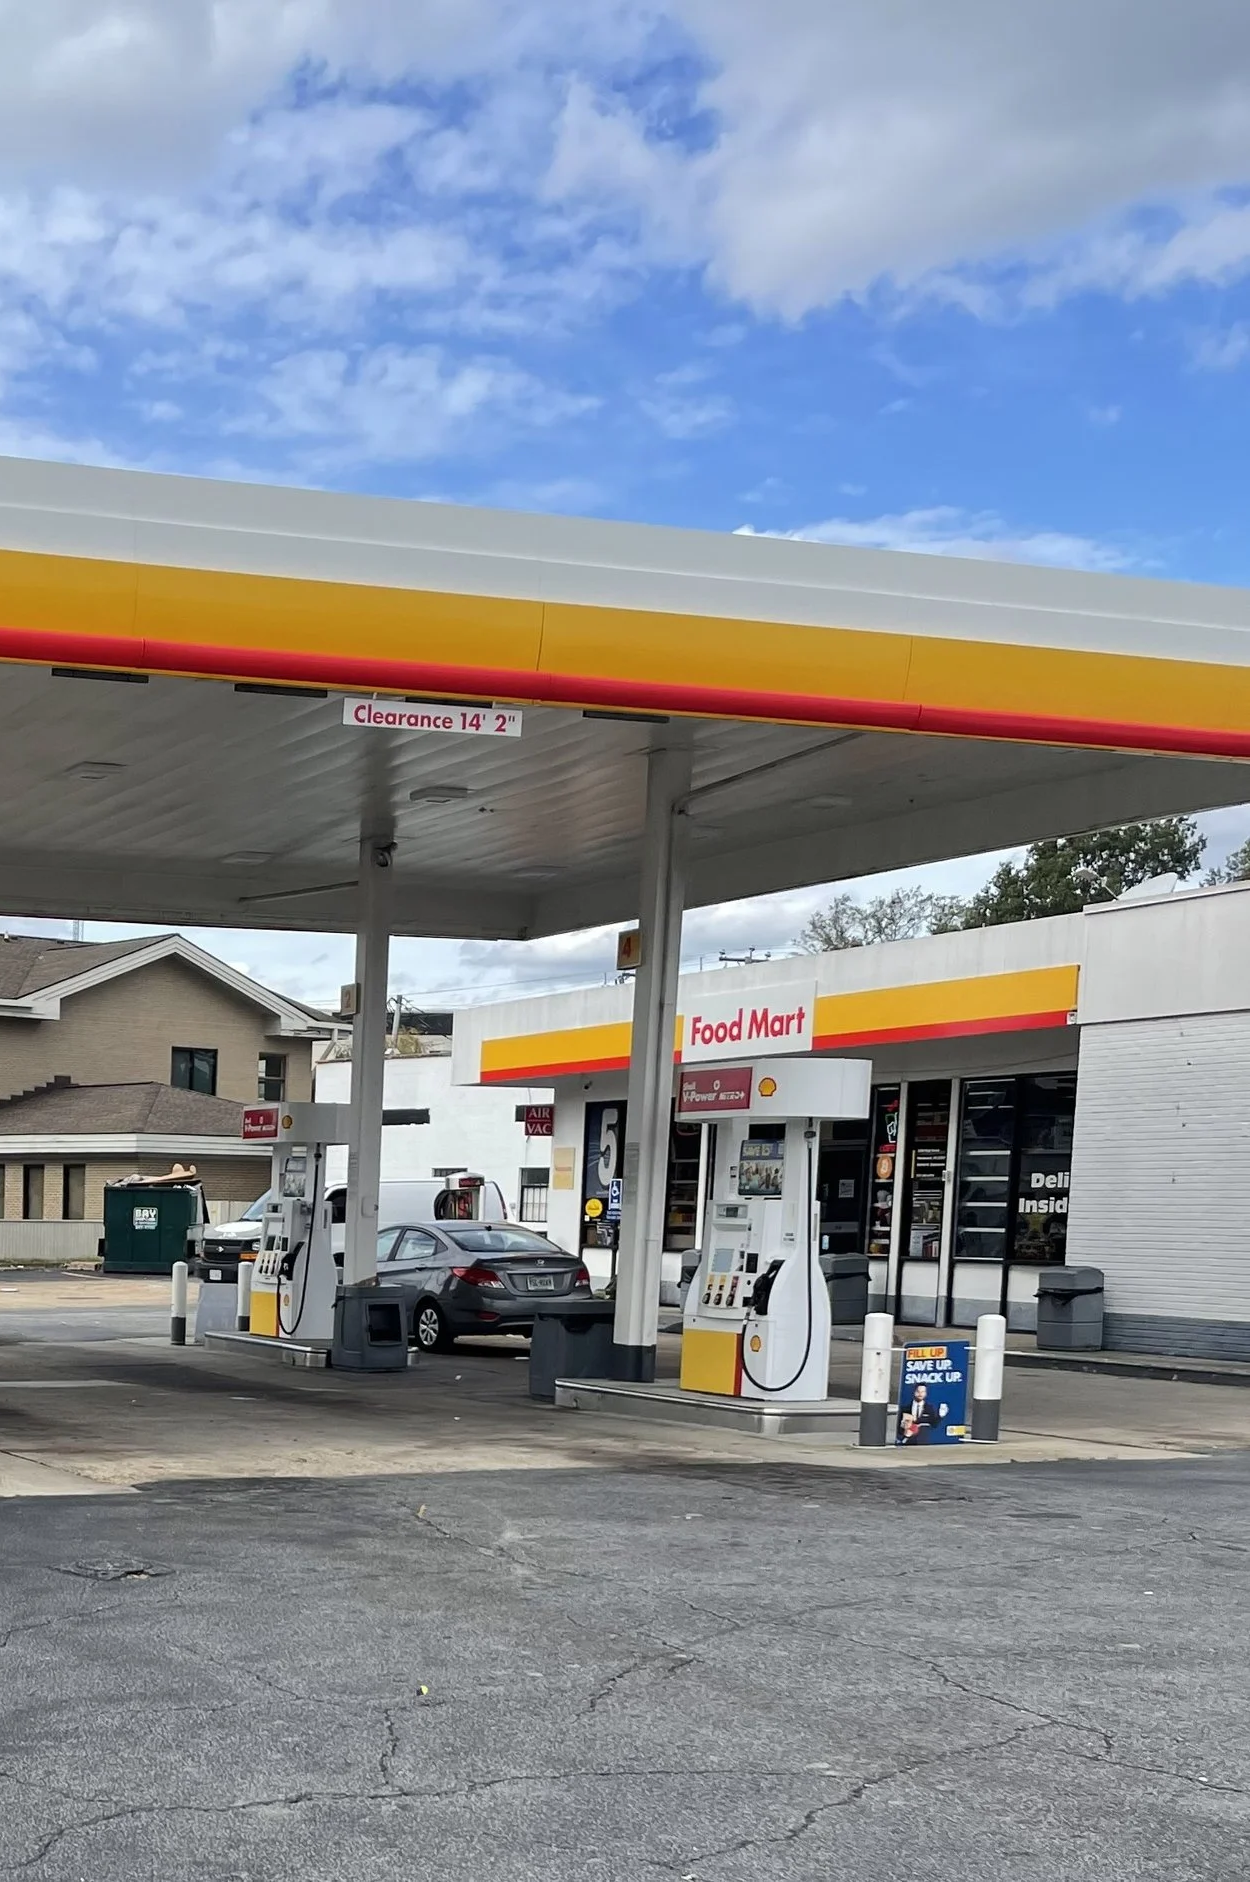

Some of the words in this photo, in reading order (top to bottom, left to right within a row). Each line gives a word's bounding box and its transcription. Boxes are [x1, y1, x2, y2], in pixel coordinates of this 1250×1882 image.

[353, 703, 453, 730] Clearance
[460, 711, 486, 732] 14'
[494, 714, 516, 733] 2"
[691, 1007, 743, 1046] Food
[748, 1006, 805, 1040] Mart
[683, 1090, 717, 1103] V-Power
[529, 1107, 550, 1118] AIR
[527, 1123, 551, 1134] VAC
[1031, 1172, 1070, 1188] Deli
[135, 1209, 156, 1219] BAY
[908, 1350, 924, 1358] FILL
[906, 1360, 934, 1371] SAVE
[936, 1359, 952, 1370] UP.
[905, 1374, 943, 1384] SNACK
[946, 1372, 962, 1382] UP.
